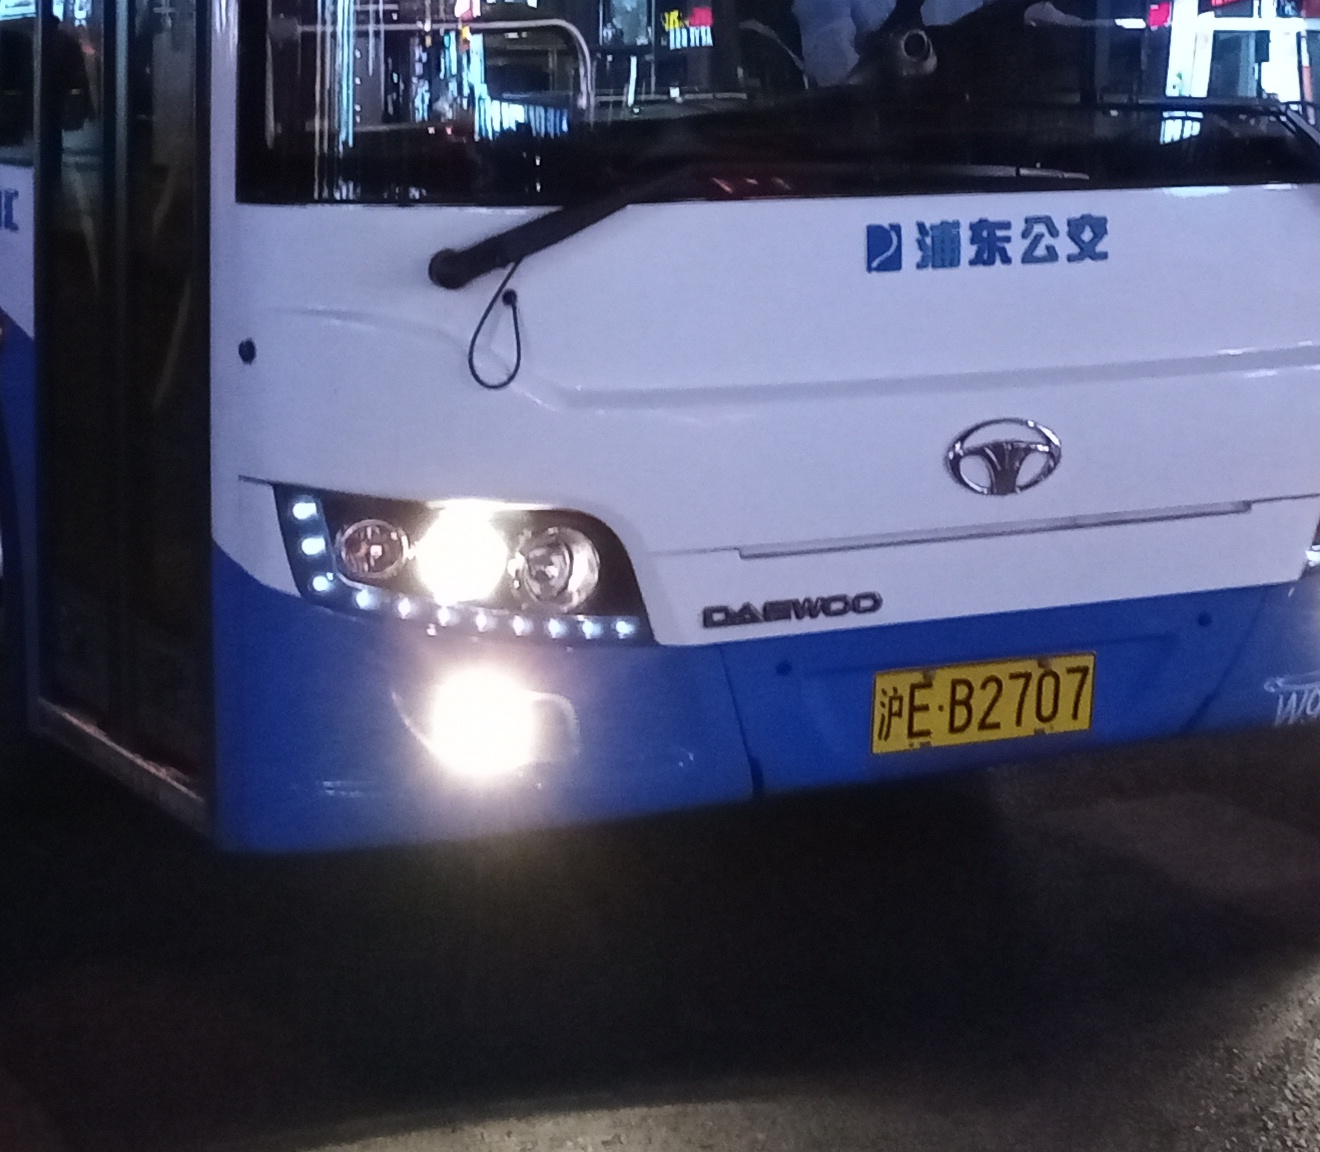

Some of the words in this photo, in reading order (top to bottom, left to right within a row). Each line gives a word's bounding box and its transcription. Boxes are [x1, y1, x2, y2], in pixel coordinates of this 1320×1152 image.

[916, 214, 1108, 269] 浦东公交
[702, 592, 881, 629] DAEWOO
